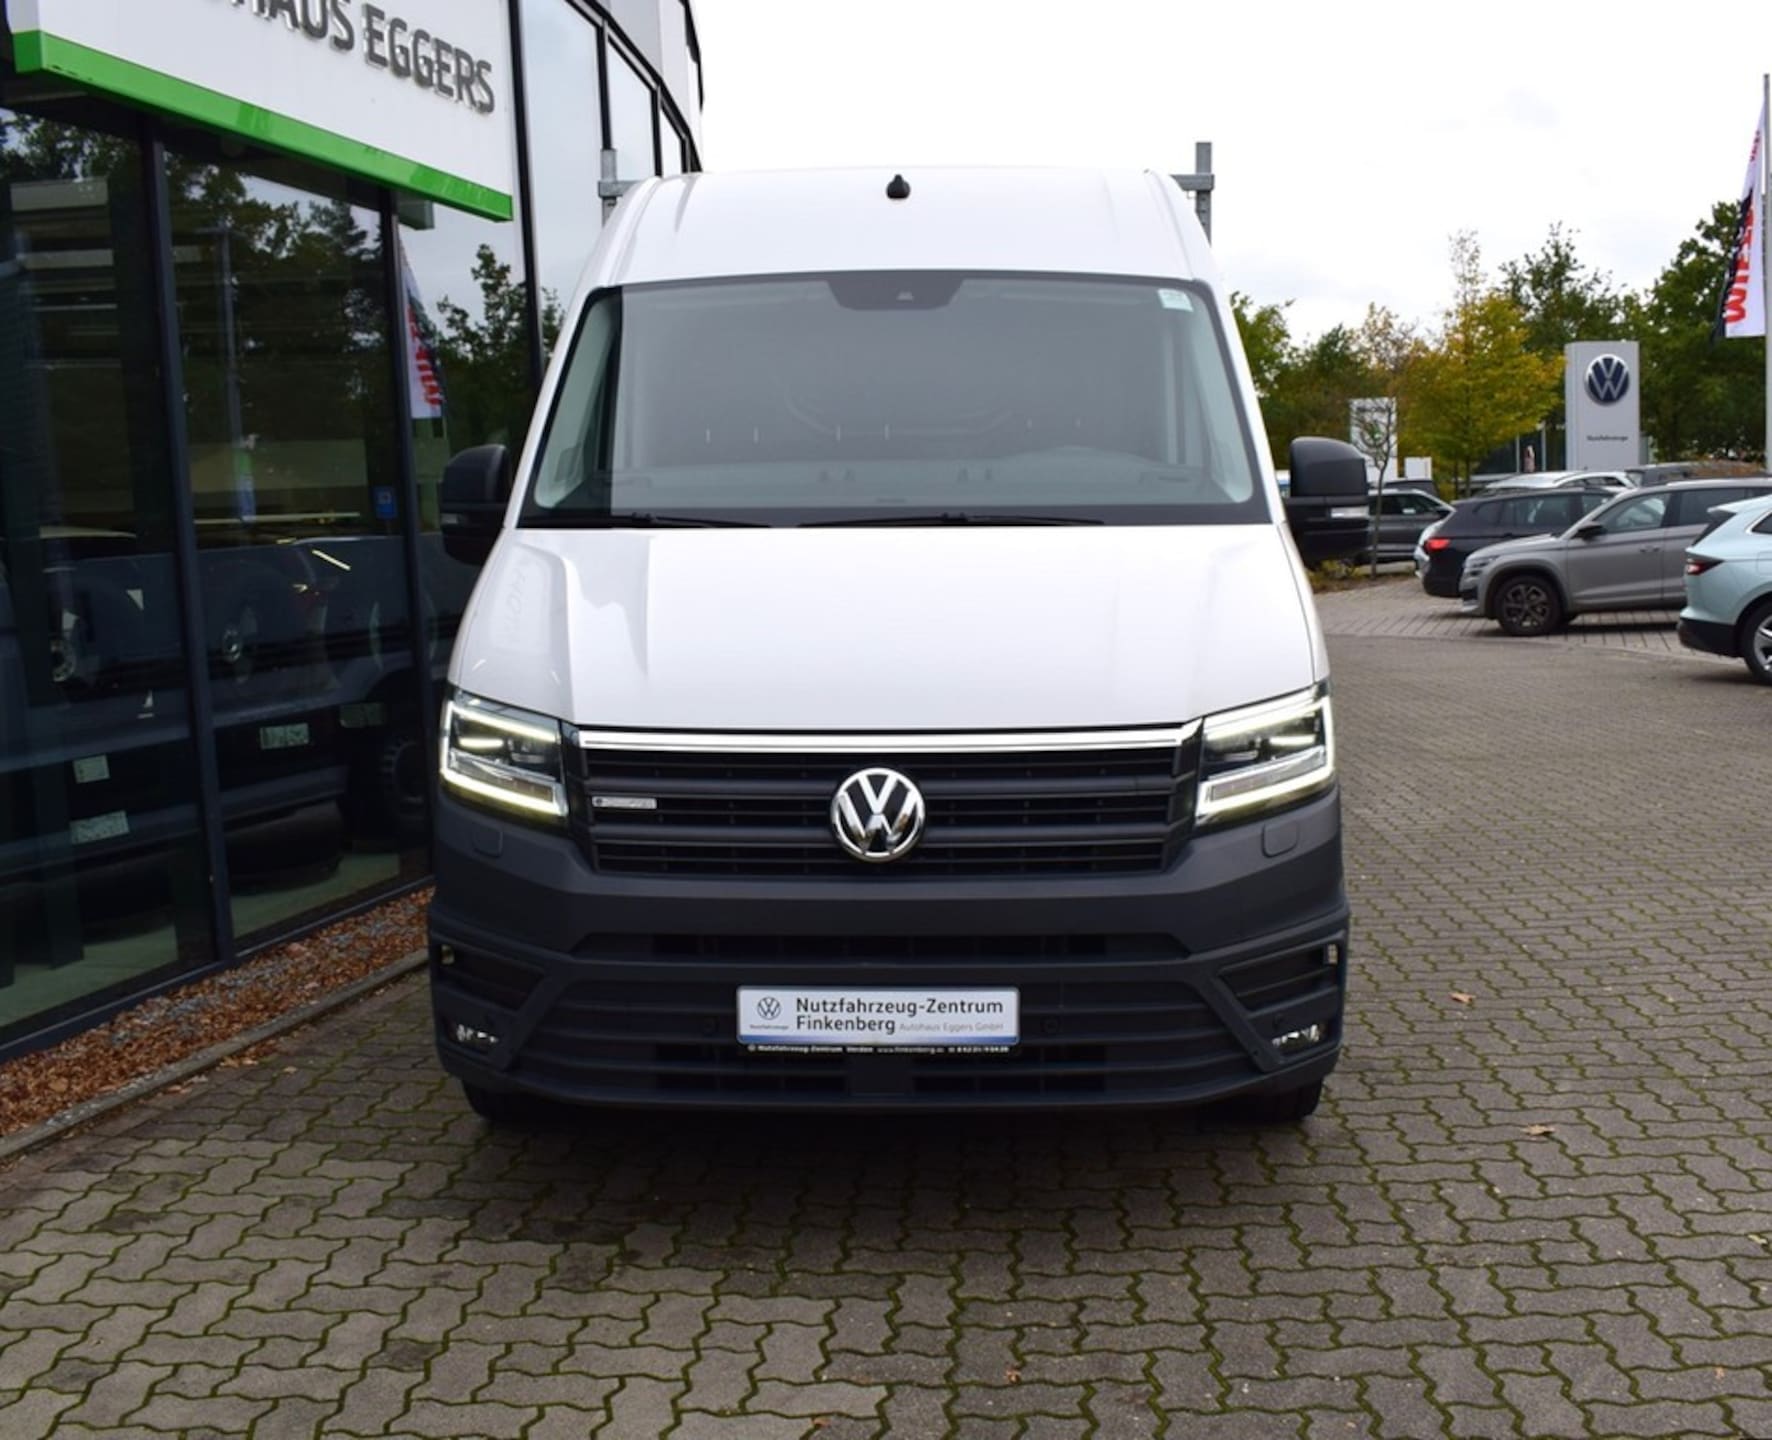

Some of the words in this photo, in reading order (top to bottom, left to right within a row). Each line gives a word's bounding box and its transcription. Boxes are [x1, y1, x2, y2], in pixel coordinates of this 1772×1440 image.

[362, 3, 495, 113] EGGERS
[831, 767, 925, 862] VW
[796, 997, 1004, 1018] Nutzfahrzeug-Zentrum
[796, 1015, 896, 1035] Finkenberg
